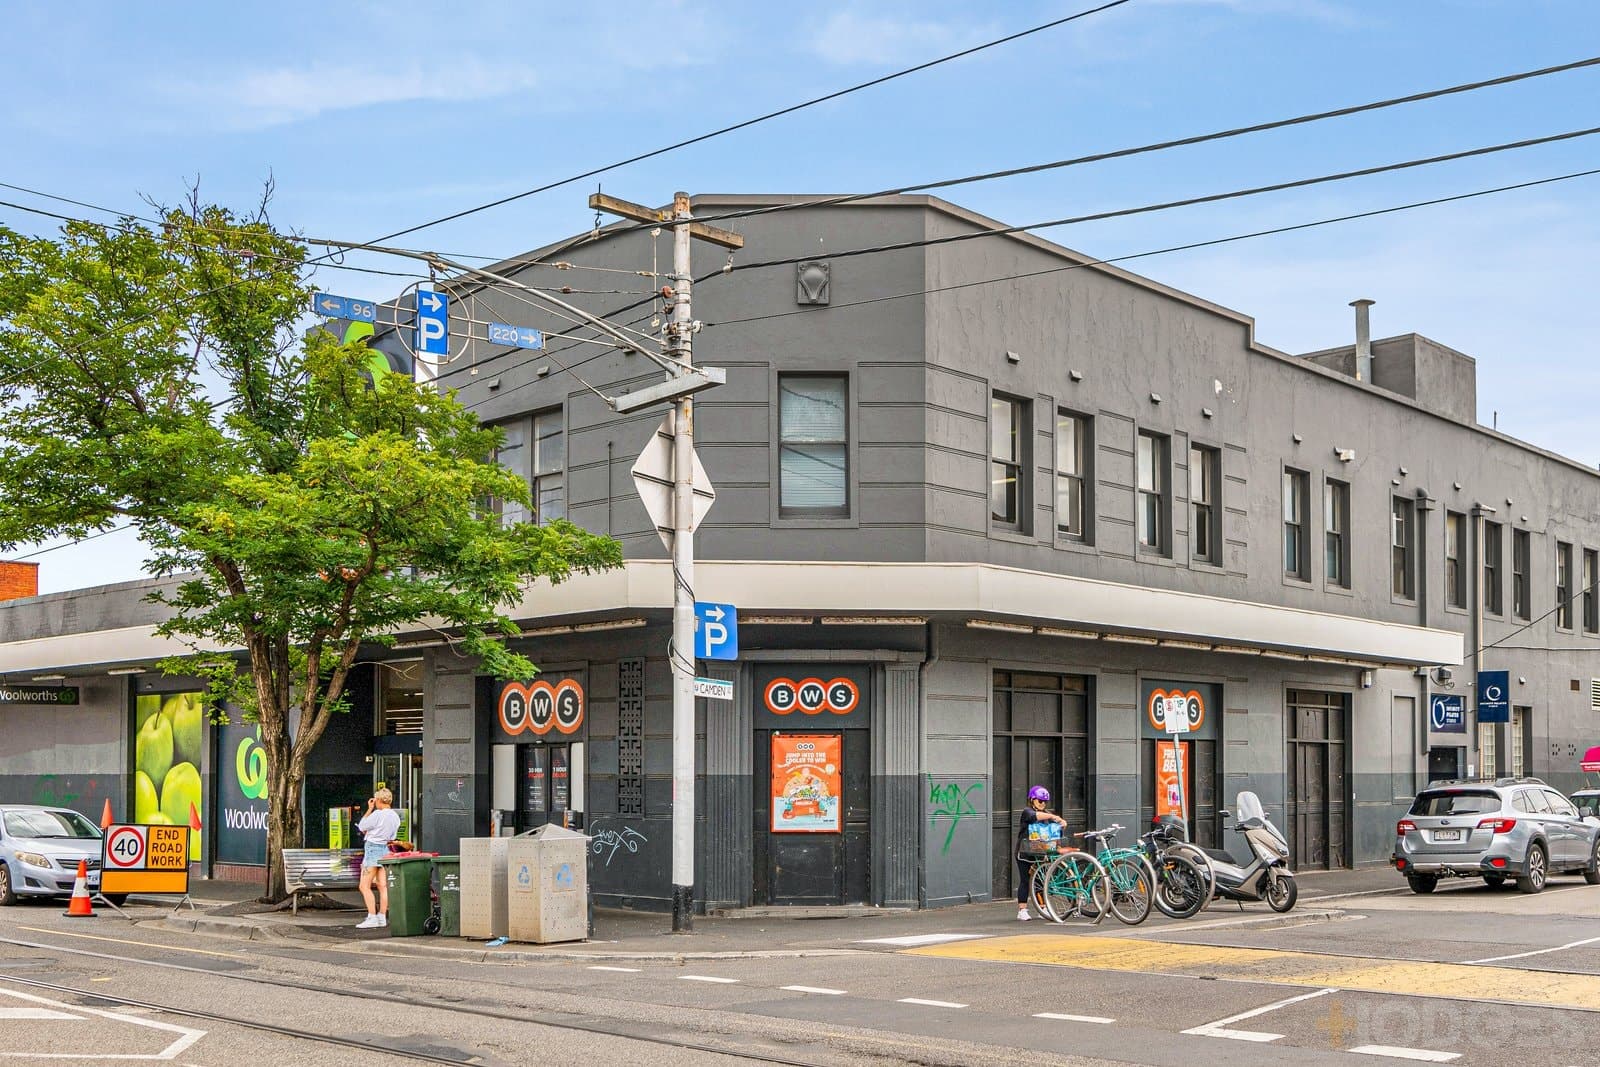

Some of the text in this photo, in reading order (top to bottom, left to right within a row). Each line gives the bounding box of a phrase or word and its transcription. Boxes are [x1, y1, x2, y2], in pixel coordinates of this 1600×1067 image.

[353, 303, 372, 318] 96
[420, 317, 445, 350] P
[493, 328, 518, 342] 220
[705, 622, 728, 657] P
[700, 684, 726, 696] CAMDEN
[777, 689, 846, 703] BWS
[510, 697, 573, 718] BWS
[1156, 702, 1197, 718] BS
[157, 830, 179, 840] END
[114, 838, 139, 856] 40
[152, 843, 183, 853] ROAD
[151, 856, 182, 866] WORK
